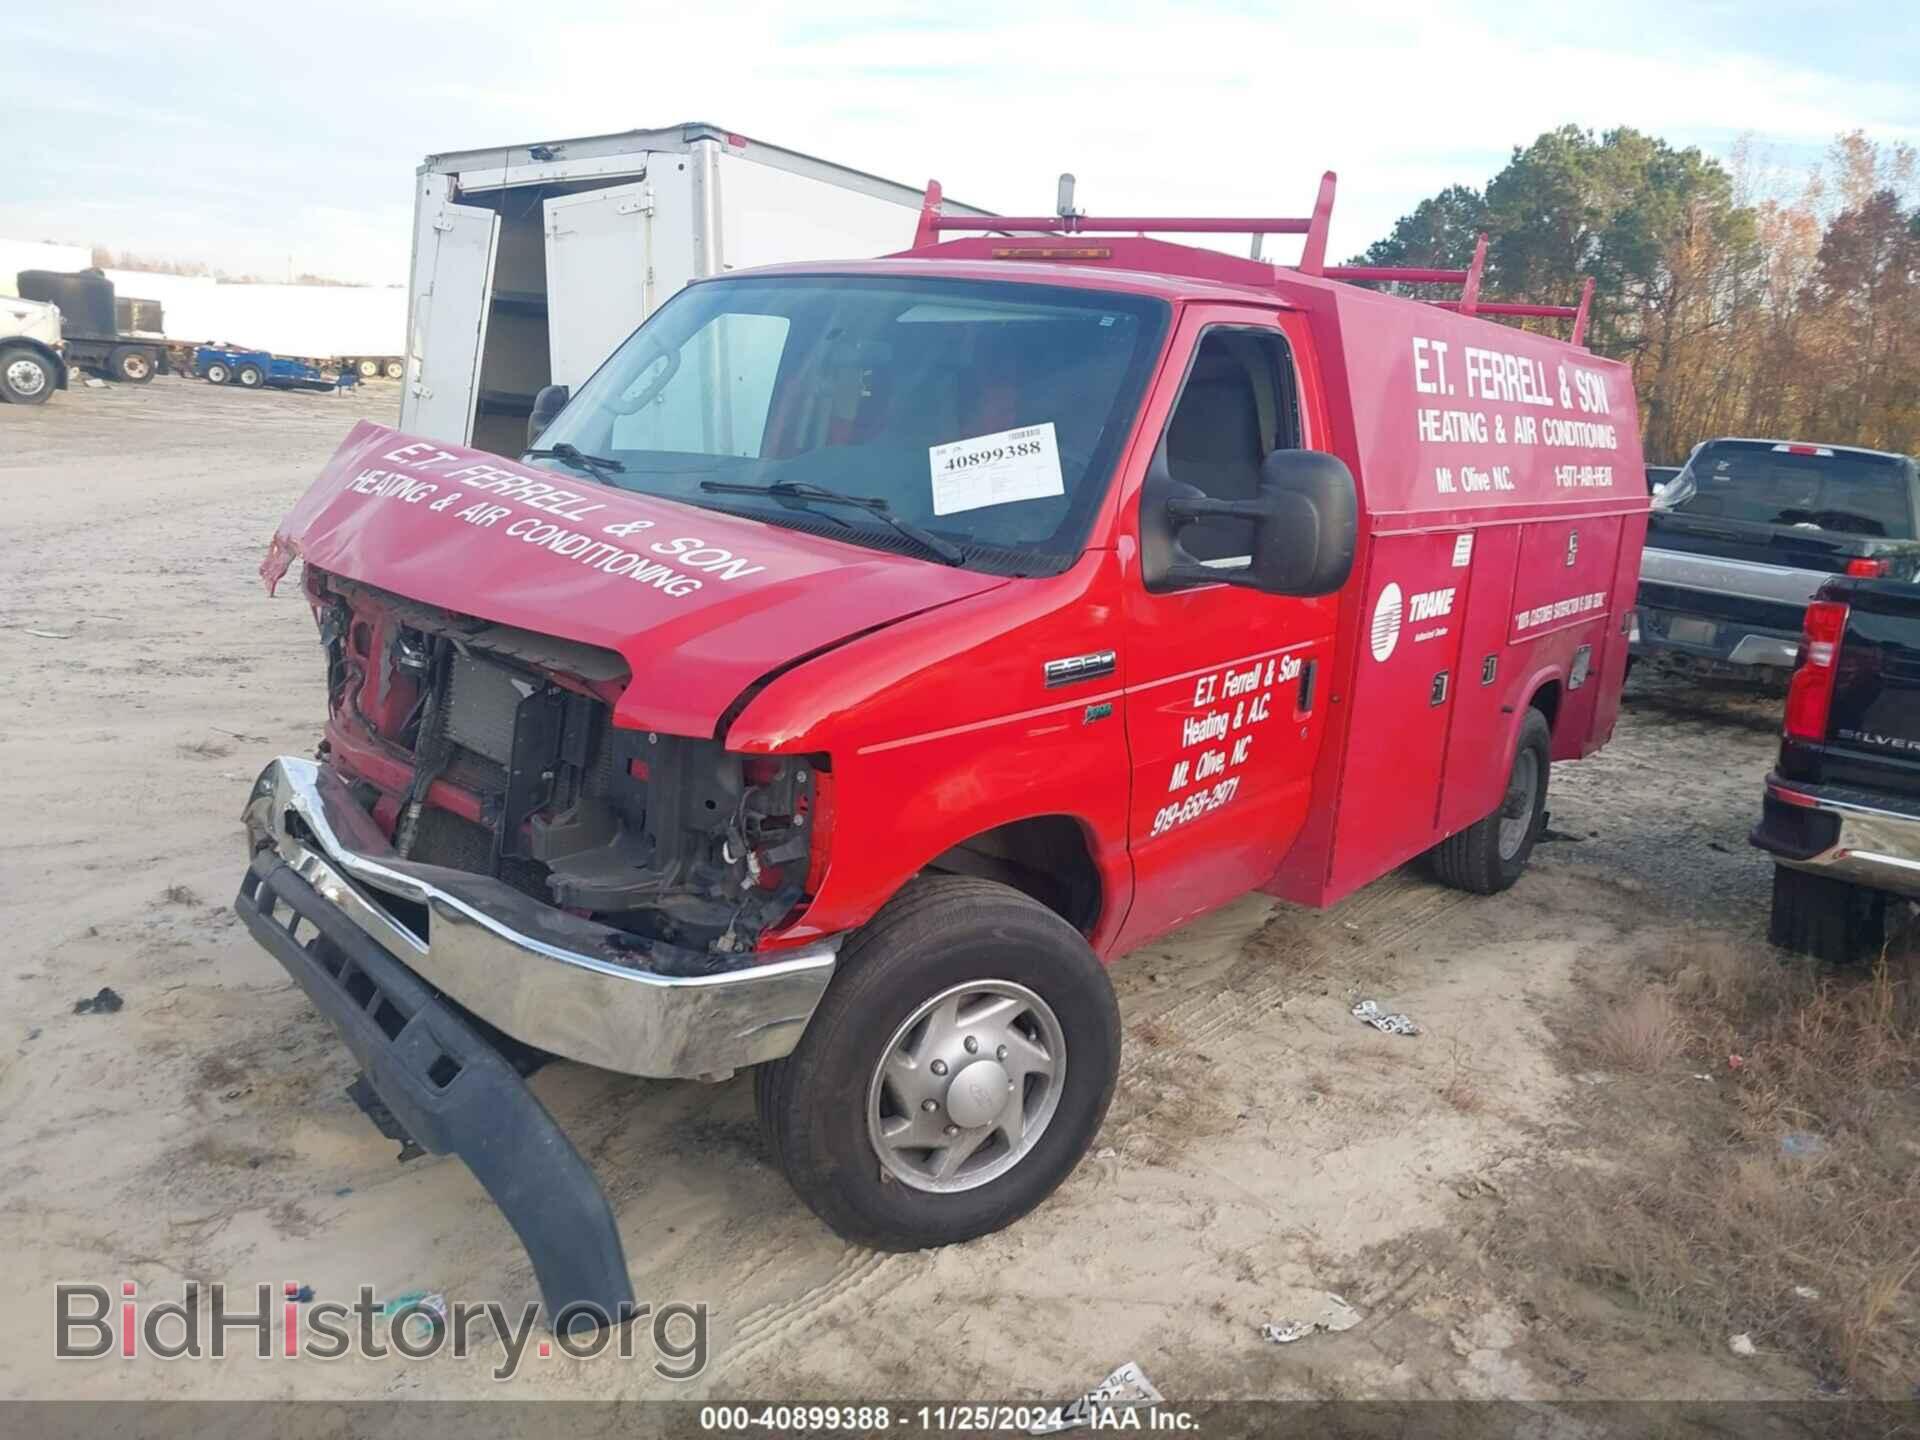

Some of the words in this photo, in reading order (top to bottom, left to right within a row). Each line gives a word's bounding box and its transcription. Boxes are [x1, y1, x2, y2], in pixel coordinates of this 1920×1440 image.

[1464, 346, 1554, 406] FERRELL
[1558, 364, 1573, 409] &
[1575, 368, 1610, 415] SON
[1417, 408, 1489, 444] HEATING
[1495, 414, 1507, 444] &
[1514, 415, 1538, 445] AIR
[1542, 417, 1617, 450] CONDITIONING
[944, 440, 1041, 471] 40899388
[1435, 466, 1457, 494] Mt.
[1461, 465, 1490, 493] Olive
[344, 468, 439, 504] HEATING
[429, 492, 464, 512] &
[453, 502, 513, 529] AIR
[505, 518, 703, 599] CONDITIONING
[442, 464, 607, 522] FERRELL
[602, 519, 656, 538] &
[651, 536, 768, 582] SON
[1408, 587, 1457, 623] TRANE
[1221, 669, 1263, 700] Ferrell
[1263, 658, 1276, 687] &
[1277, 654, 1302, 684] Son
[1182, 709, 1230, 749] Heating
[1232, 700, 1245, 730] &
[1168, 760, 1190, 793] Mt.
[1230, 734, 1253, 767] NC
